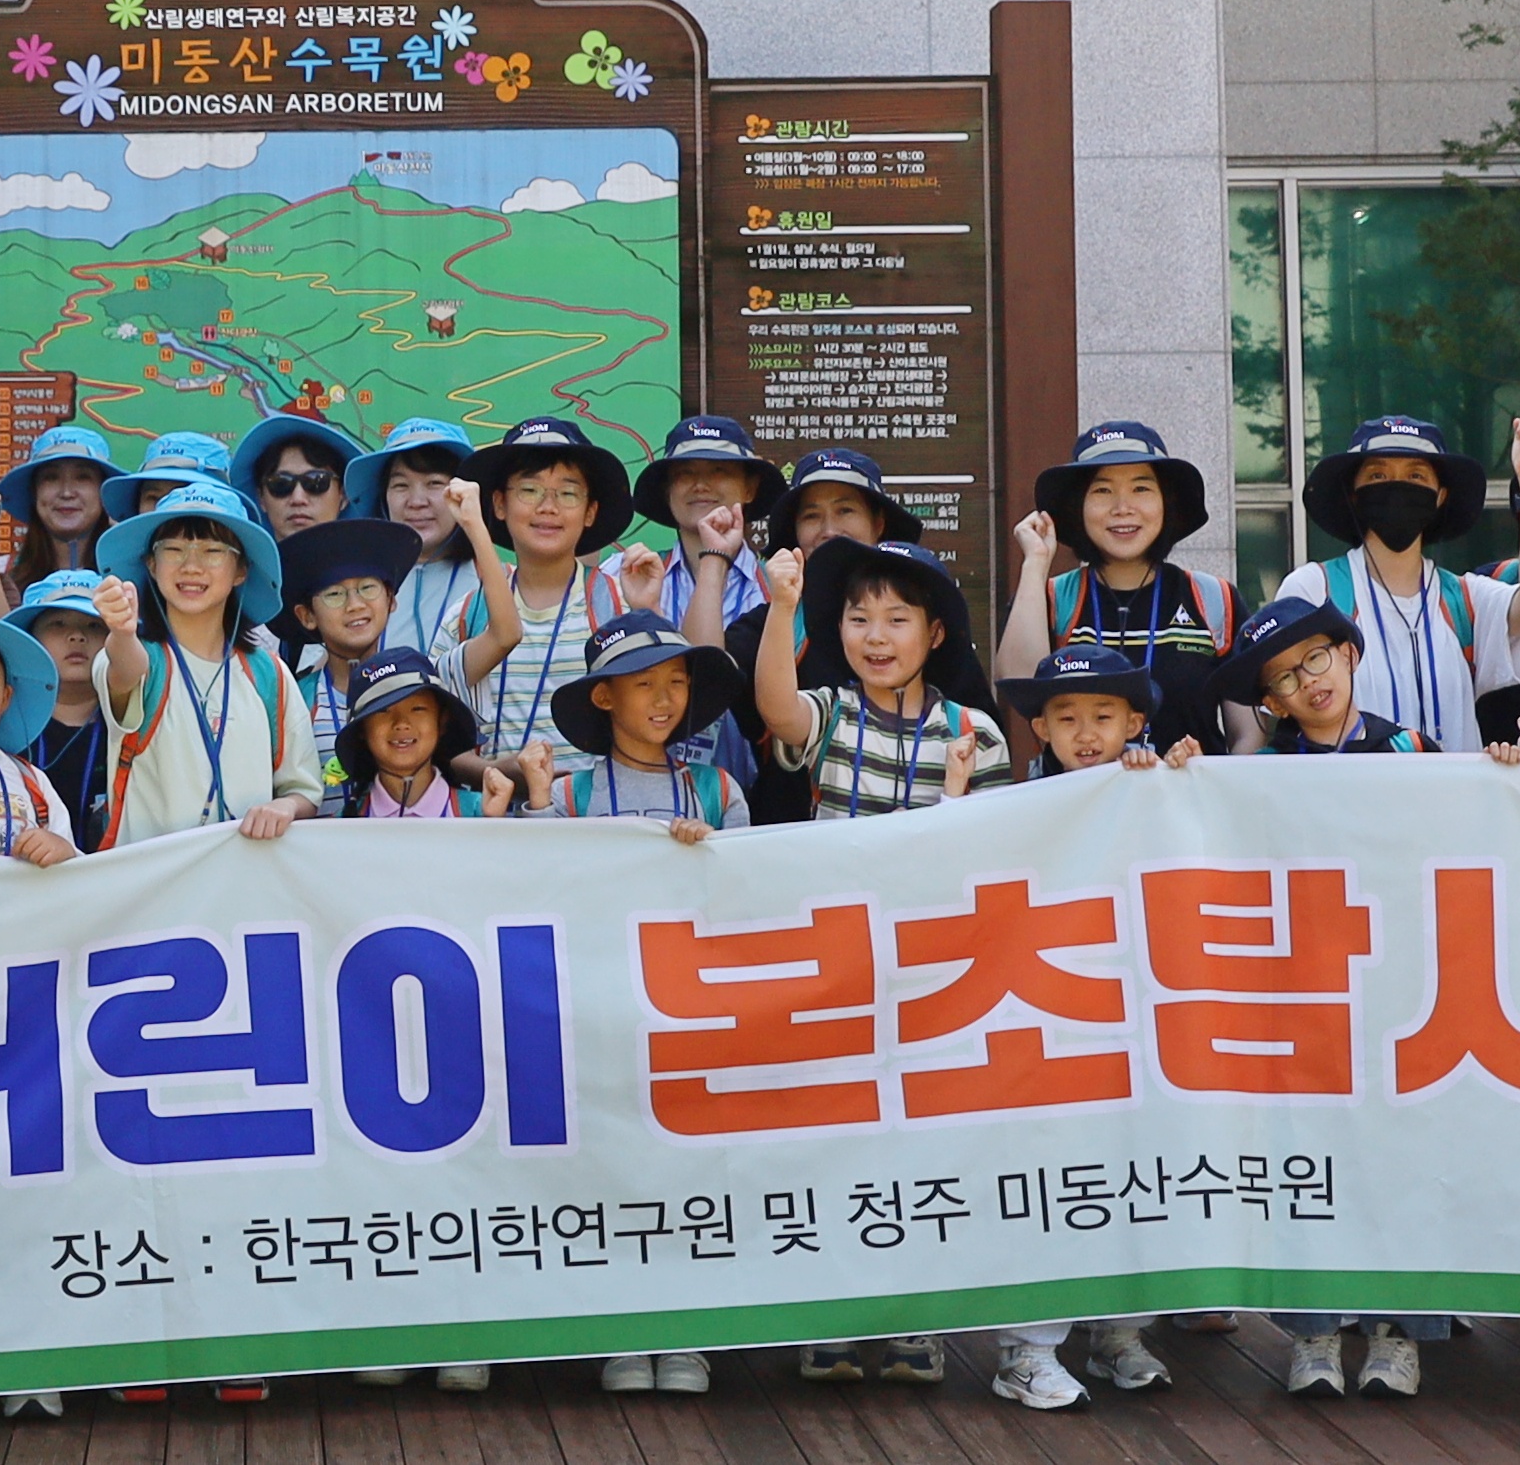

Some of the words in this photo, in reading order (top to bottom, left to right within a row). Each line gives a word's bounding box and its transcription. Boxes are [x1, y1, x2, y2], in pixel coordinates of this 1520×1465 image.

[145, 7, 286, 30] 산림생태연구와
[295, 6, 416, 27] 산림복지공간
[120, 94, 273, 115] MIDONGSAN
[285, 92, 443, 113] ARBORETUM
[776, 120, 849, 138] 관람시간
[778, 211, 832, 230] 휴원일
[137, 280, 147, 288] 16
[779, 293, 852, 311] 관람코스
[221, 312, 231, 320] 17
[162, 351, 172, 360] 14
[280, 362, 290, 370] 18
[298, 398, 308, 407] 19
[360, 392, 370, 400] 21
[522, 422, 549, 435] KIOM
[693, 427, 721, 437] KIOM
[1391, 424, 1420, 435] KIOM
[1096, 430, 1124, 443] KIOM
[184, 494, 214, 504] KIOM
[1250, 617, 1278, 642] KIOM
[600, 630, 626, 650] KIOM
[369, 663, 397, 682] KIOM
[1061, 660, 1090, 672] KIOM
[49, 1228, 176, 1300] 장소
[243, 1192, 738, 1285] 한국한의학연구원
[762, 1187, 818, 1254] 및
[847, 1177, 971, 1252] 청주
[997, 1153, 1339, 1236] 미동산수목원
